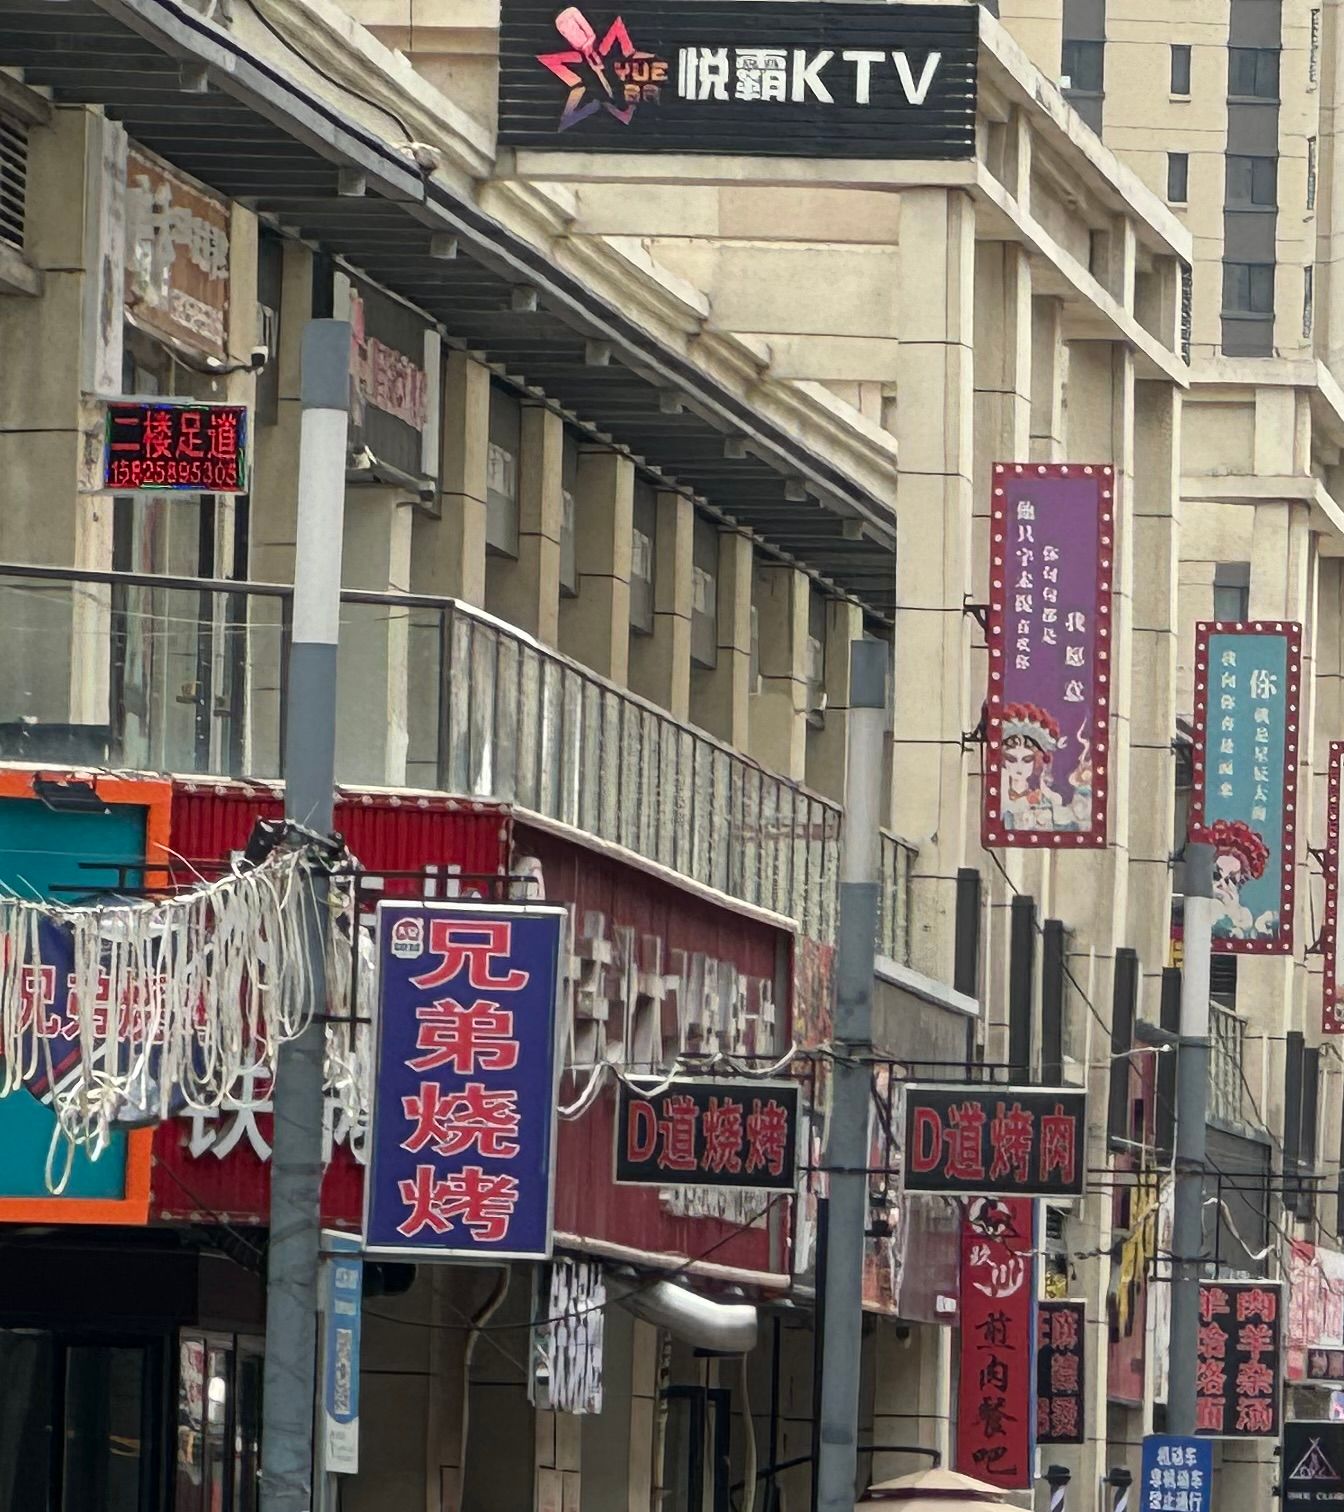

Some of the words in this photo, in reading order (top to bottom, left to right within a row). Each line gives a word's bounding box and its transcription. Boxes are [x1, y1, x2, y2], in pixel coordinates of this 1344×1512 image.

[678, 47, 942, 105] 悦霸KTV
[111, 411, 239, 460] 二楼足道
[397, 918, 529, 1242] 兄弟烧烤
[625, 1096, 789, 1177] D道烧烤
[911, 1102, 1077, 1184] D道烤肉
